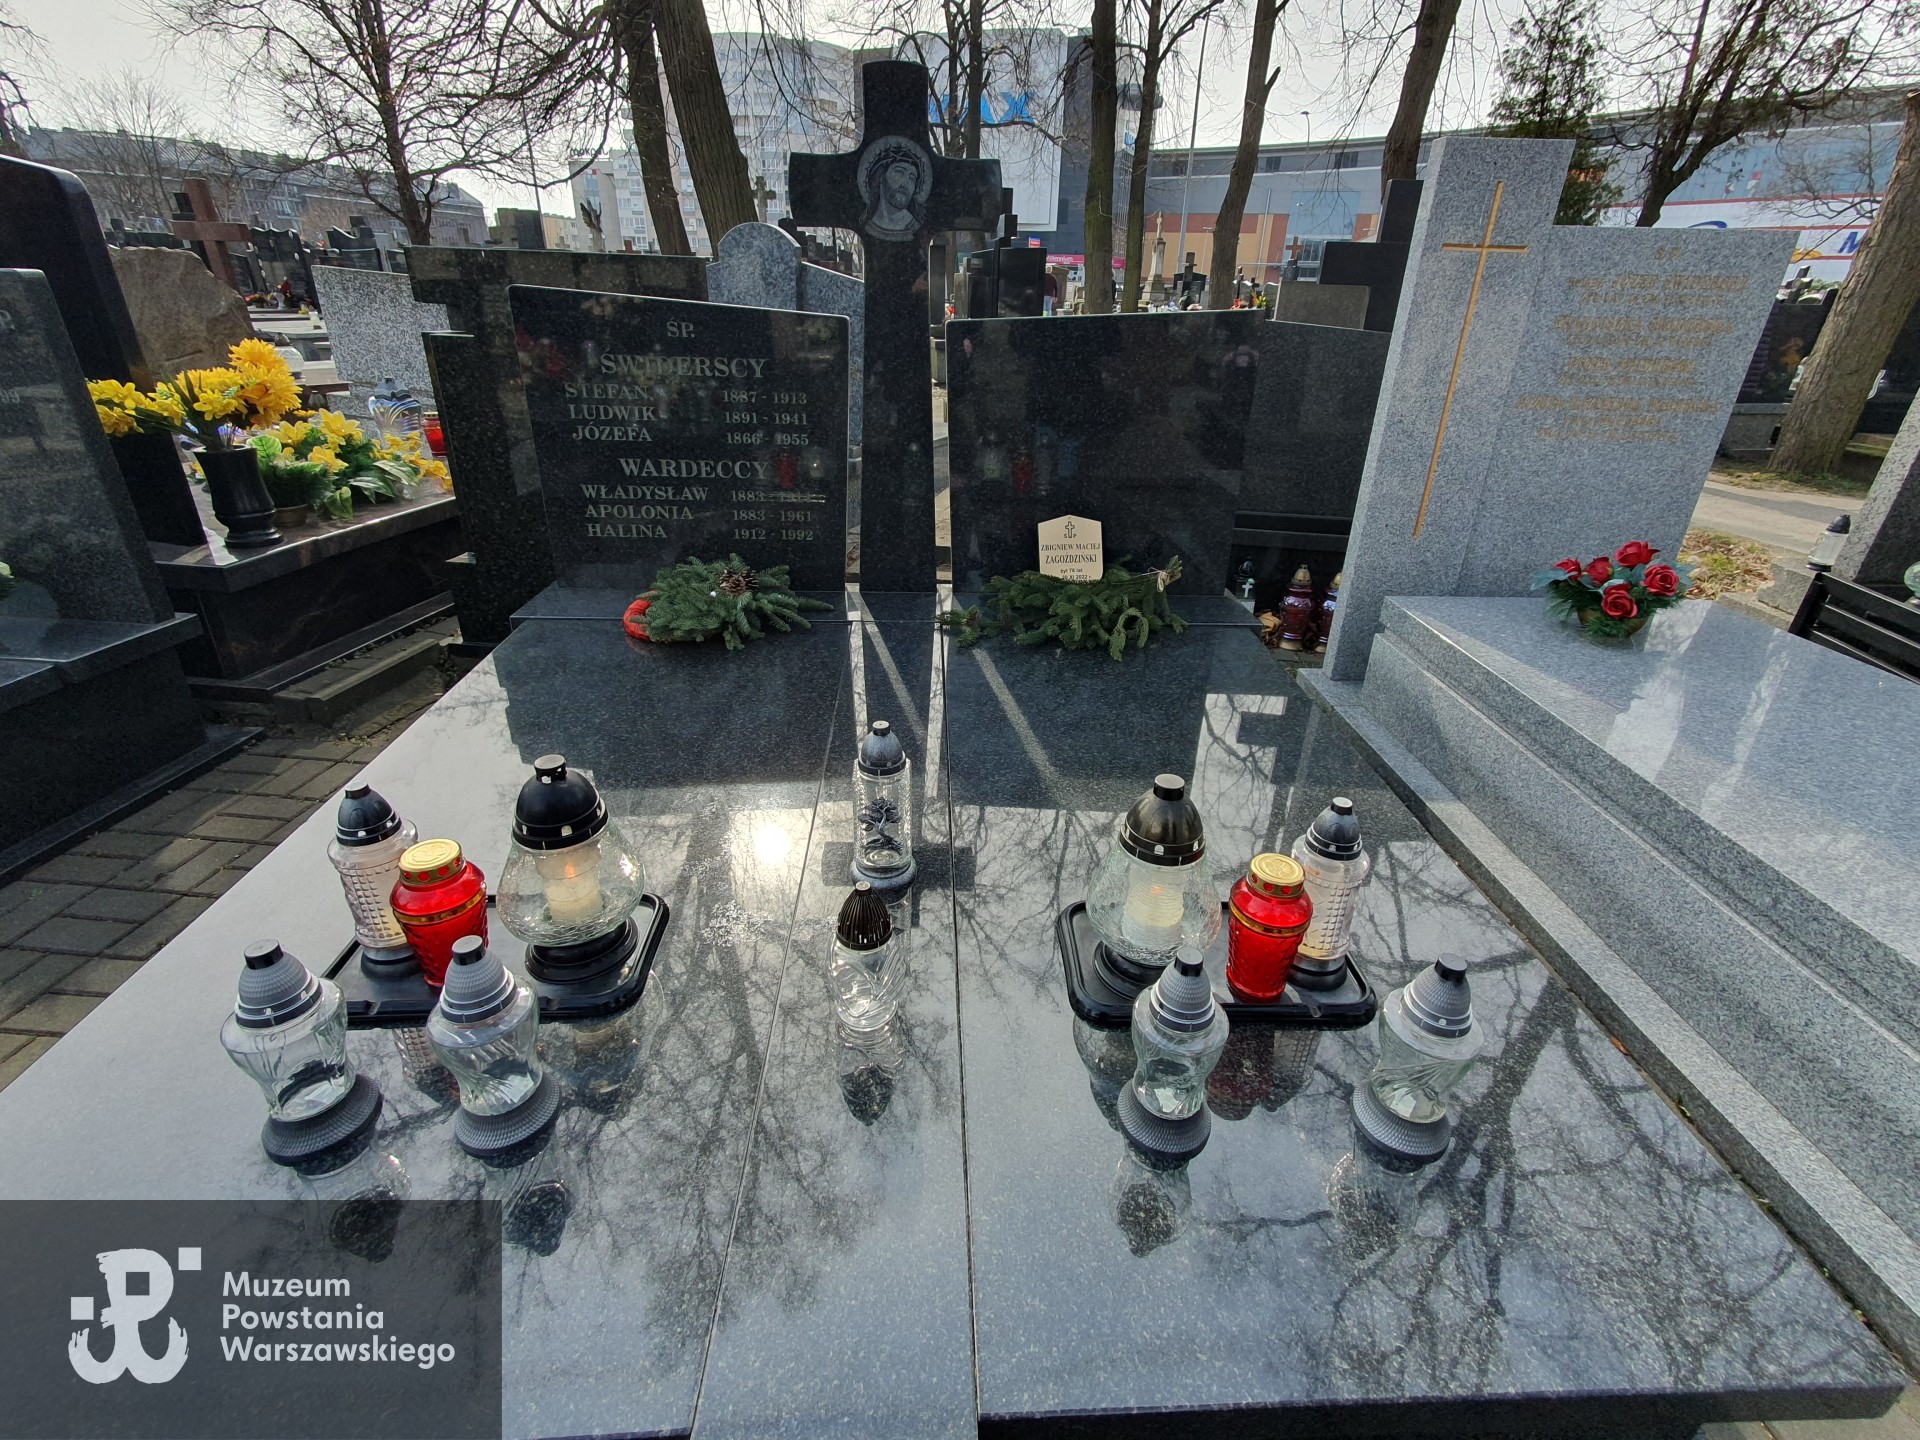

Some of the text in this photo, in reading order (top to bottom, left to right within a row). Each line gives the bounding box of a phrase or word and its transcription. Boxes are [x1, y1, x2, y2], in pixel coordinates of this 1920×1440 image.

[600, 347, 768, 378] ŚWIDERSCY
[722, 390, 757, 403] 1887
[772, 391, 807, 405] 1913
[568, 404, 658, 421] LUDWIK
[725, 411, 758, 424] 1891
[773, 412, 808, 426] 1941
[572, 421, 653, 442] JÓZEFA
[726, 431, 761, 445] 1866
[775, 433, 809, 446] 1955
[618, 457, 770, 480] WARDECCY
[580, 484, 709, 502] WŁADYSŁAW
[585, 504, 694, 521] APOLONIA
[732, 510, 765, 521] 1883
[780, 511, 811, 522] 1961
[586, 523, 668, 539] HALINA
[733, 528, 766, 540] 1912
[781, 529, 814, 541] 1992
[1041, 542, 1100, 551] ZBIGNIEW MACIEJ
